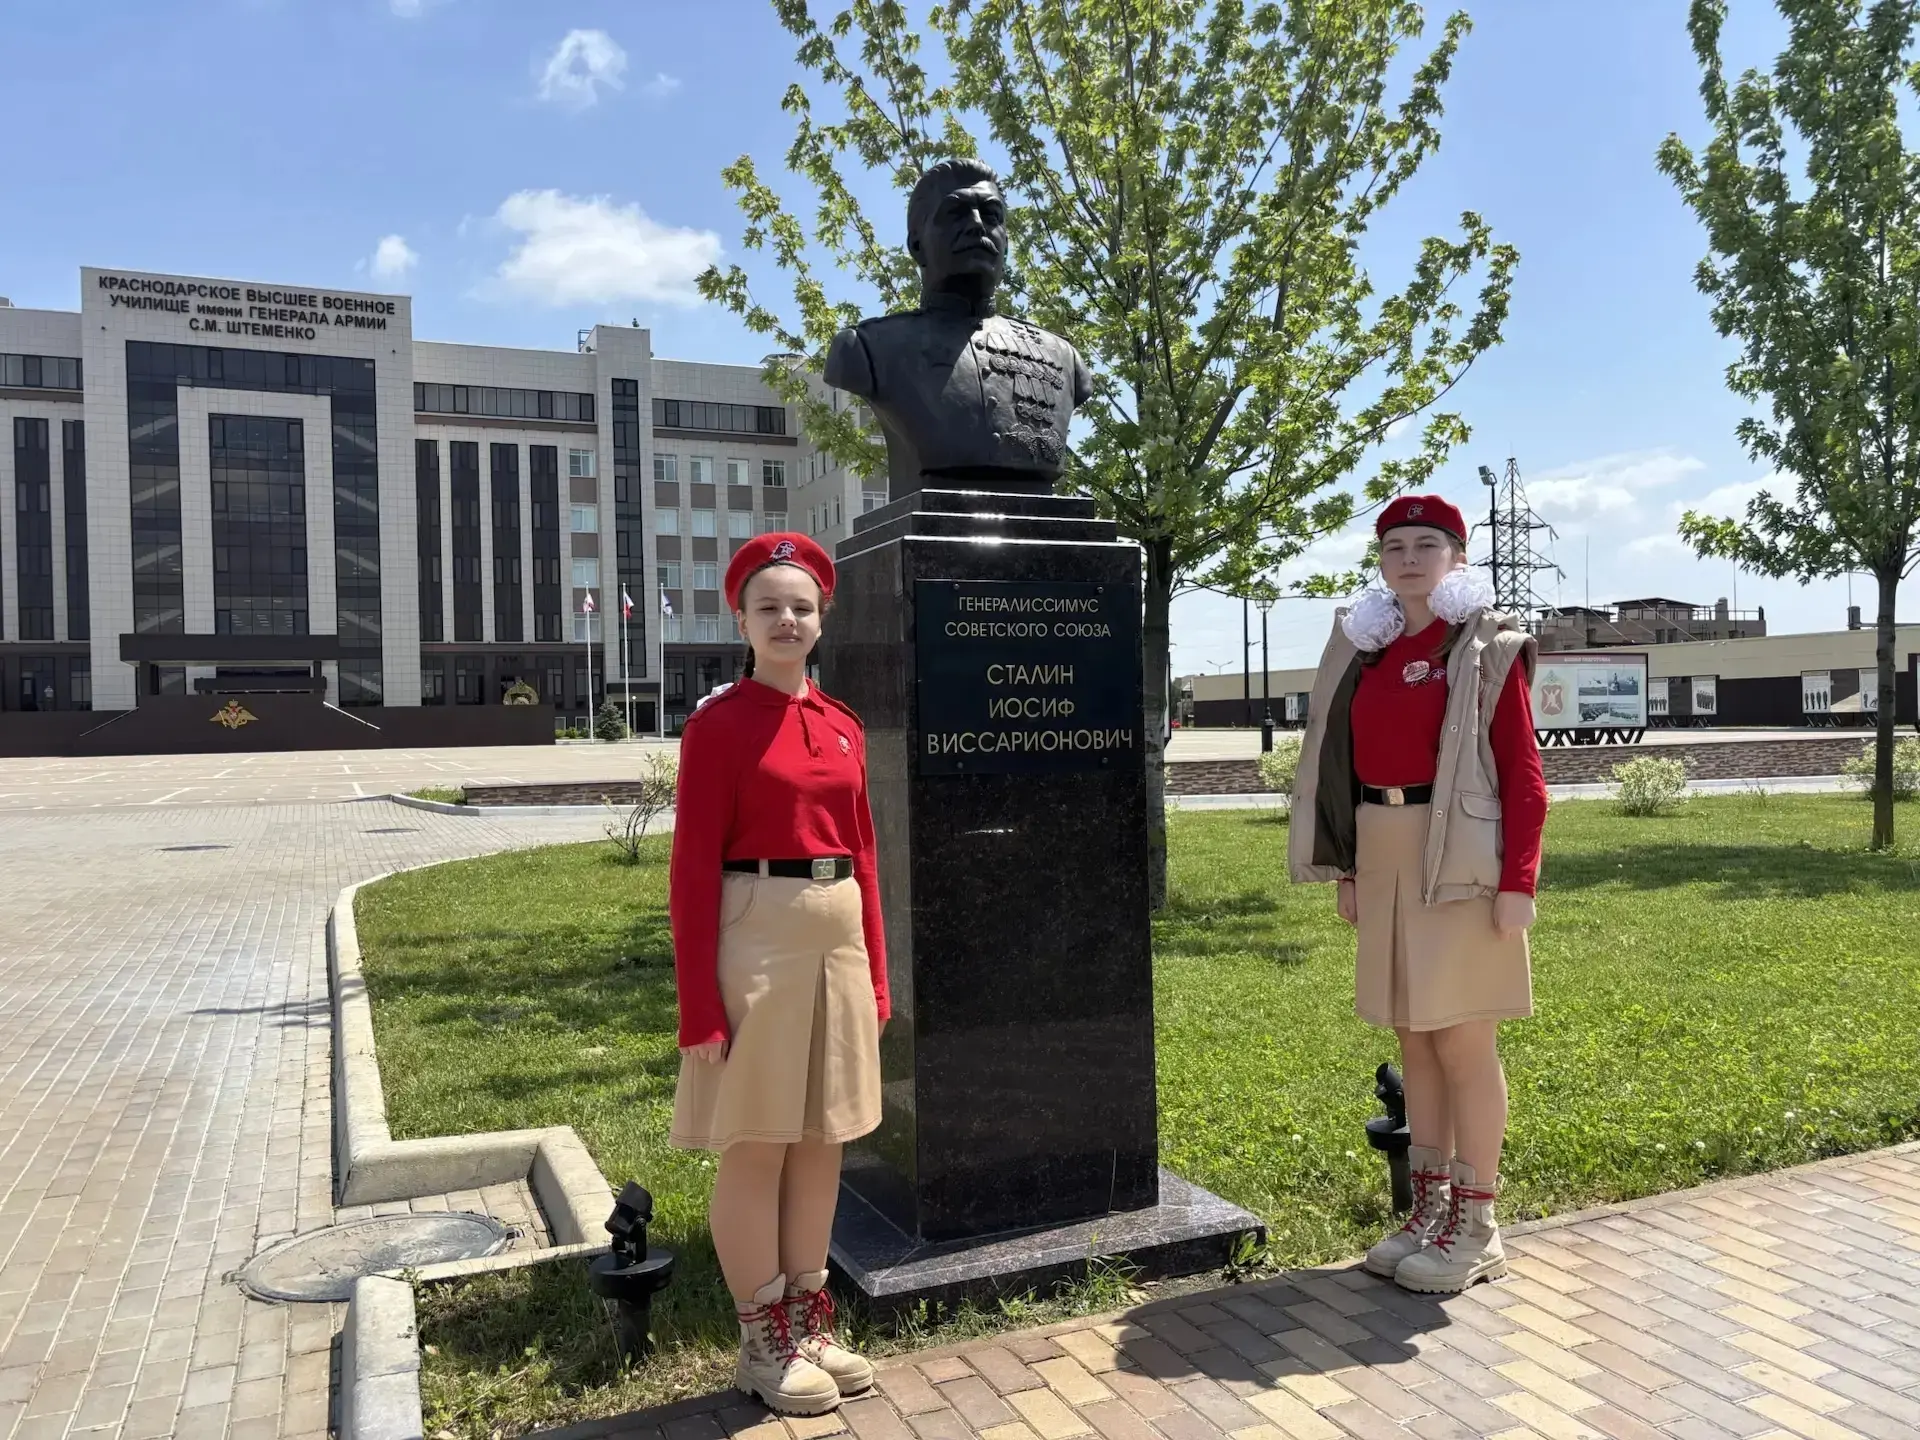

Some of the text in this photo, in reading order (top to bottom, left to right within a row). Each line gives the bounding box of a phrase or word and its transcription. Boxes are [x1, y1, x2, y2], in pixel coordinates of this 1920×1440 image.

[99, 276, 396, 315] КРАСНОДАРСКОЕ ВЫСШЕЕ ВОЕННОЕ
[110, 294, 387, 330] УЧИЛИЩЕ имени ГЕНЕРАЛА АРМИИ
[189, 317, 316, 340] С.М. ШТЕМЕНКО
[958, 596, 1099, 613] ГЕНЕРАЛИССИМУС
[944, 621, 1111, 638] СОВЕТСКОГО СОЮЗА
[986, 664, 1074, 685] СТАЛИН
[988, 697, 1075, 719] ИОСИФ
[927, 729, 1133, 755] ВИССАРИОНОВИЧ
